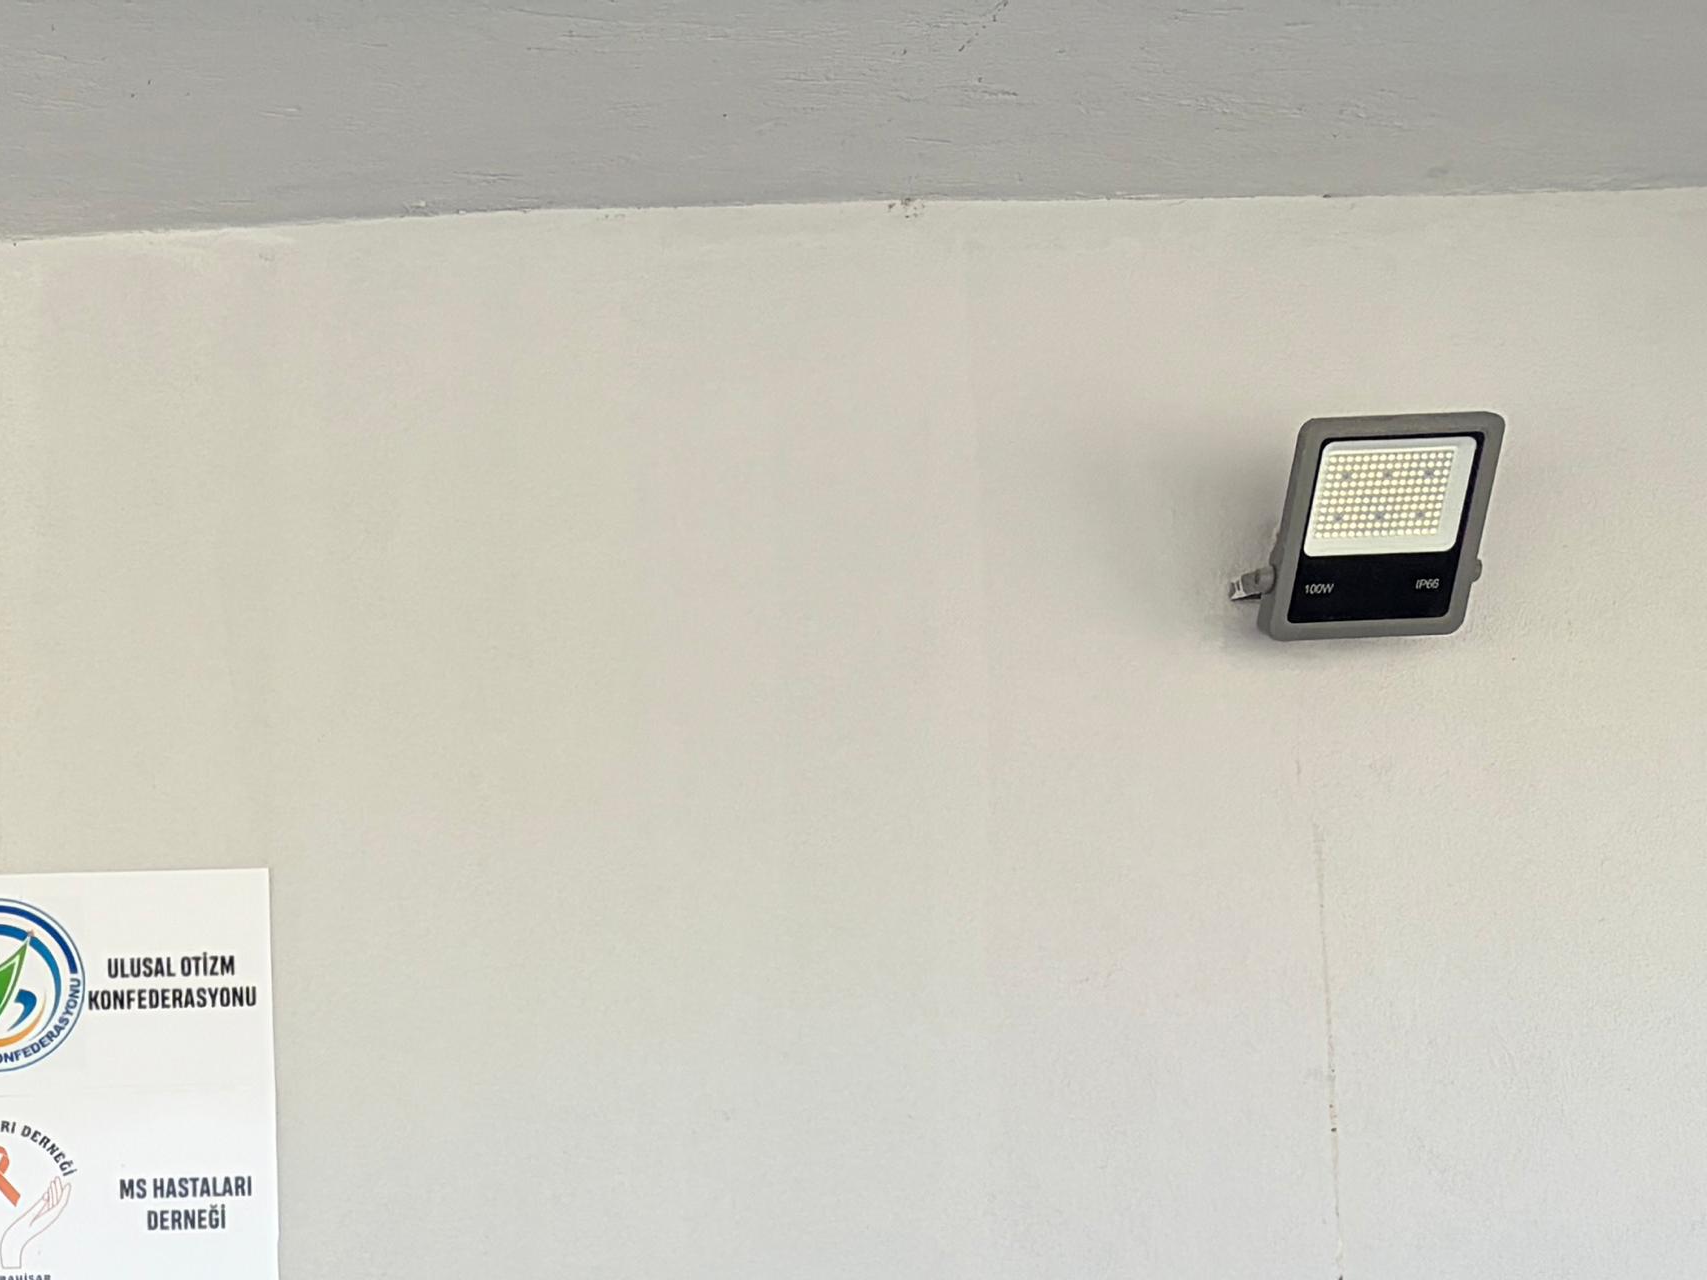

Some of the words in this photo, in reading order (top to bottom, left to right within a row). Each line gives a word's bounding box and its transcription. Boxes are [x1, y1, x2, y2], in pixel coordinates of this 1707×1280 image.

[108, 956, 176, 978] ULUSAL
[181, 951, 235, 977] OTİZM
[88, 986, 257, 1010] KONFEDERASYONU
[119, 1178, 147, 1199] MS
[153, 1176, 252, 1198] HASTALARI
[147, 1204, 226, 1230] DERNEĞİ
